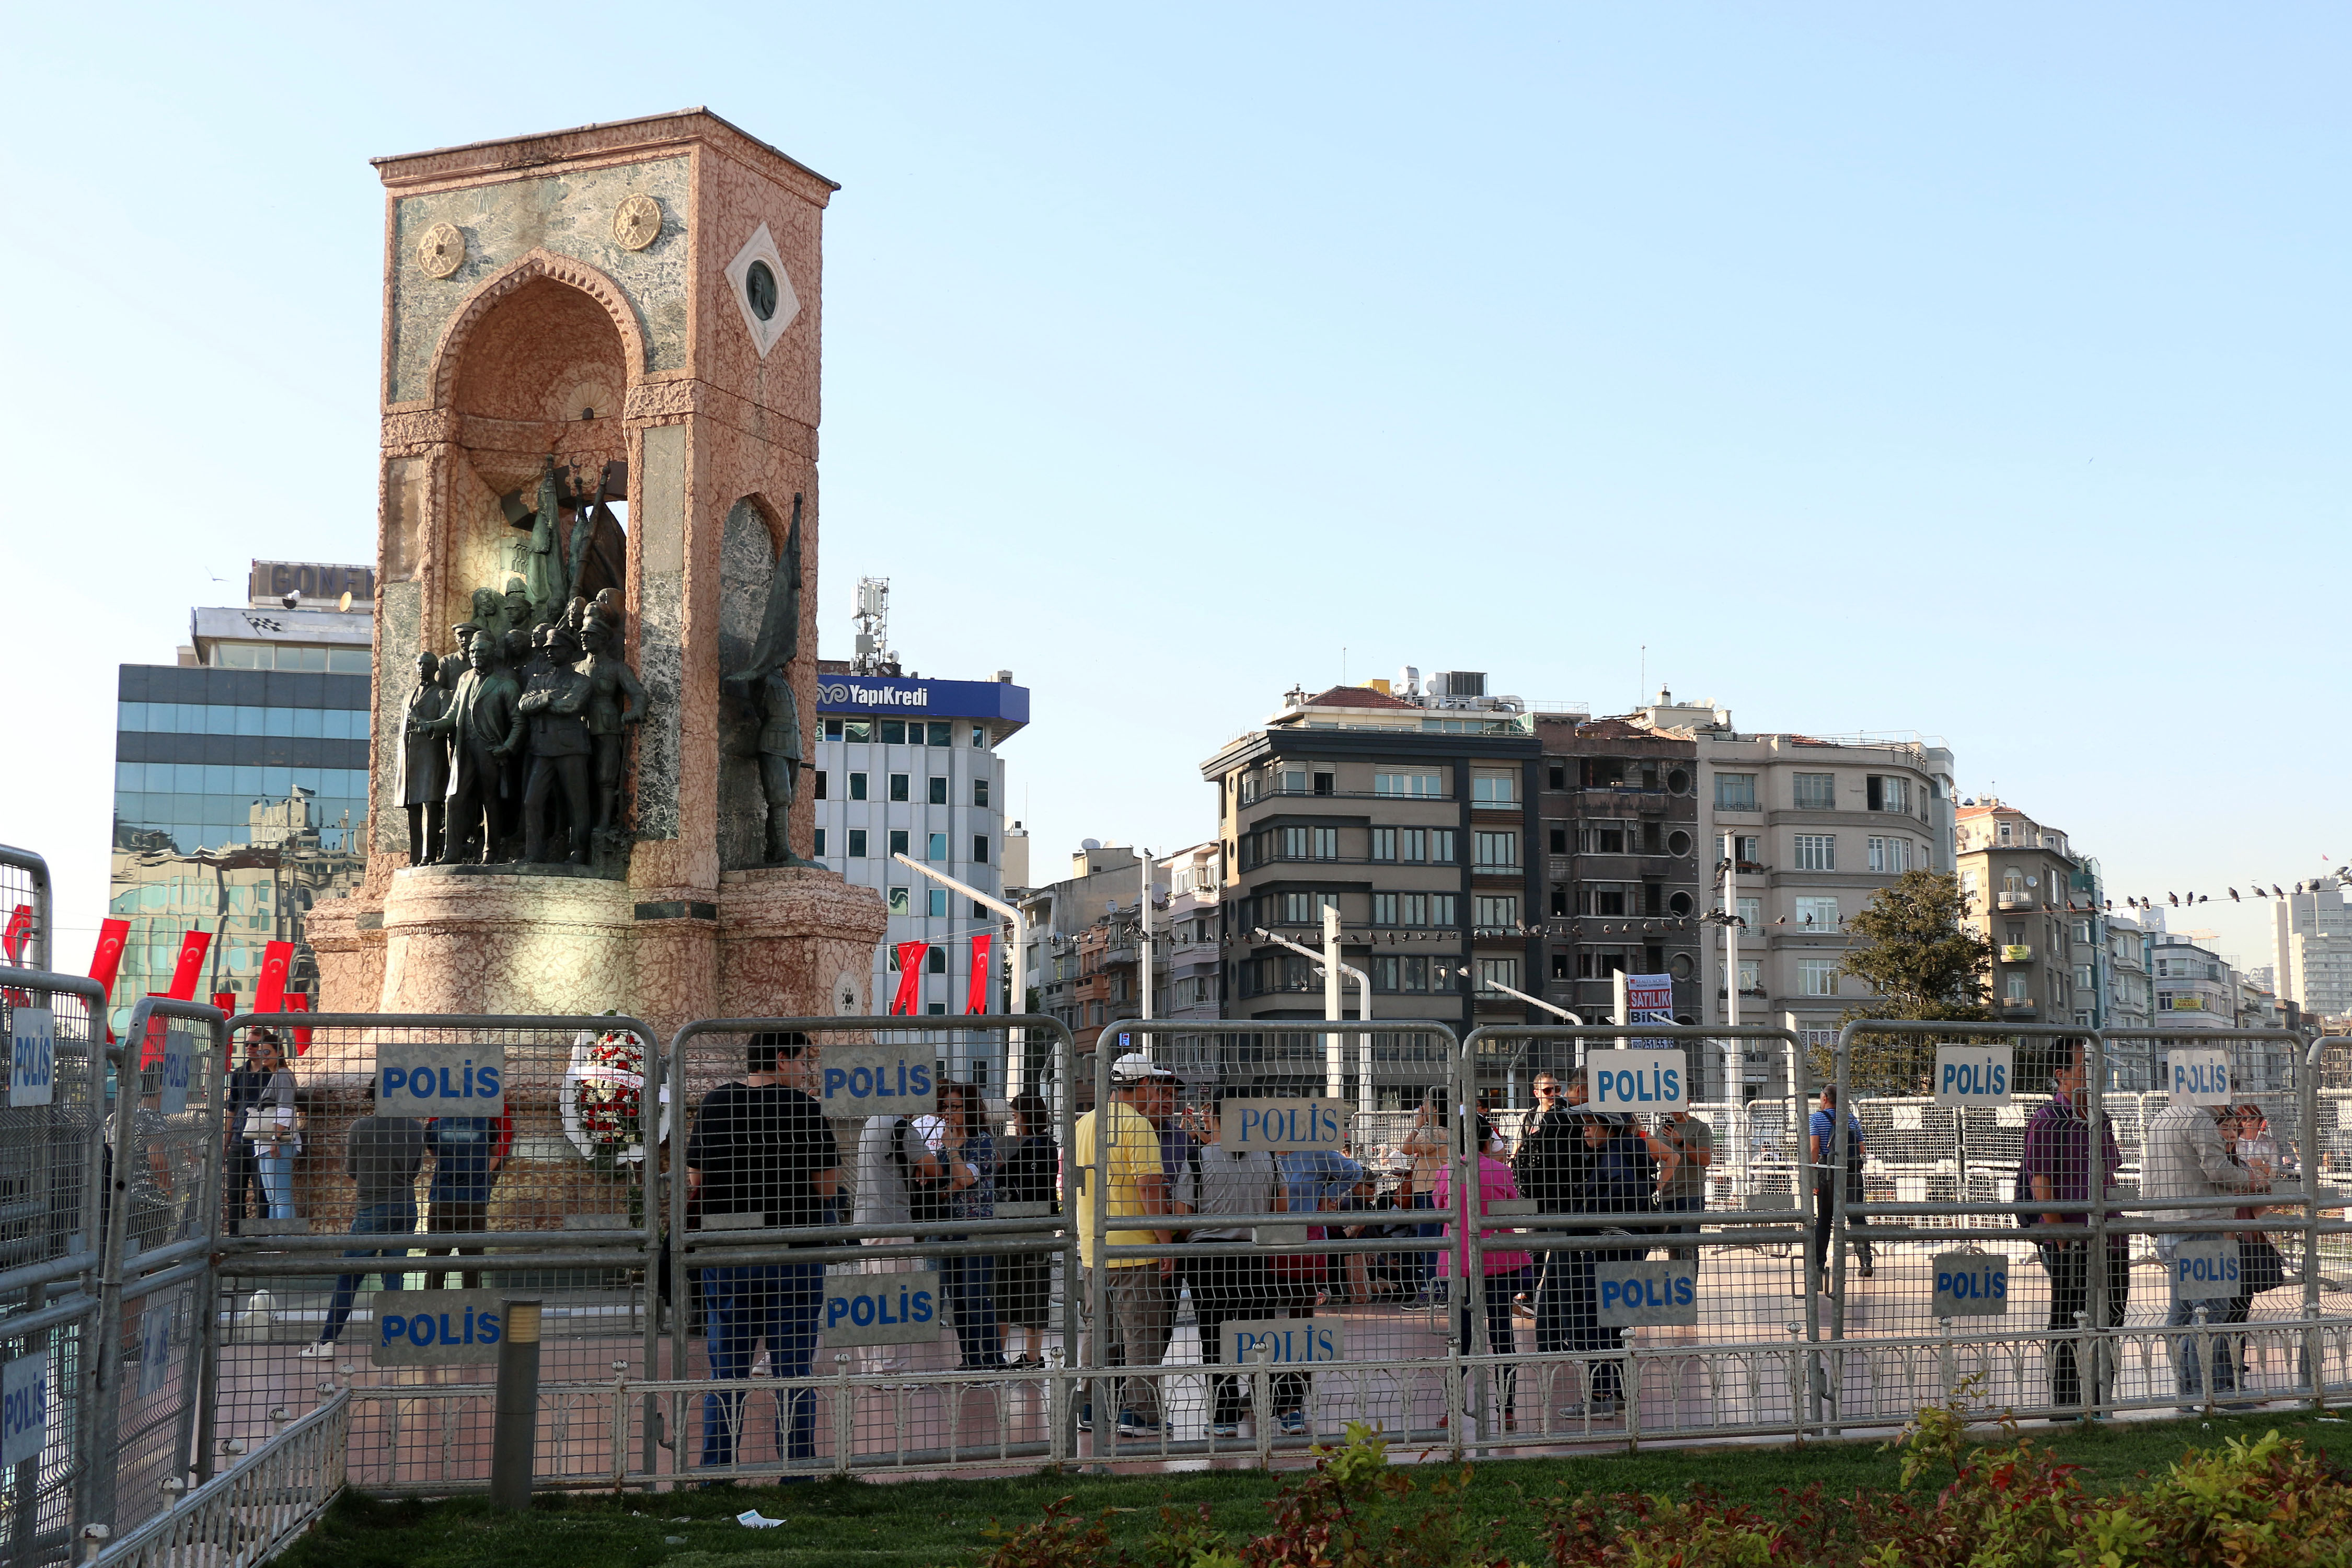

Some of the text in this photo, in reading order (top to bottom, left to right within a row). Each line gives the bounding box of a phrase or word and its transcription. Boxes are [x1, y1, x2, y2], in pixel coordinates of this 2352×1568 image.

[849, 684, 927, 707] YapıKredi
[1631, 991, 1669, 1008] SATILIK
[14, 1024, 51, 1087] POLİS
[383, 1059, 500, 1098] POLİS
[824, 1059, 931, 1099] POLİS
[1598, 1062, 1680, 1102] POLİS
[1943, 1057, 2005, 1095] POLİS
[2175, 1057, 2227, 1094] POLİS
[1238, 1102, 1338, 1142] POLİS
[1938, 1265, 2005, 1300] POLİS
[2179, 1251, 2238, 1282] POLİS
[827, 1285, 933, 1328] POLİS
[1601, 1272, 1693, 1309] POLİS
[382, 1306, 500, 1347] POLİS
[1234, 1324, 1334, 1363] POLİS
[4, 1371, 46, 1439] POLİS
